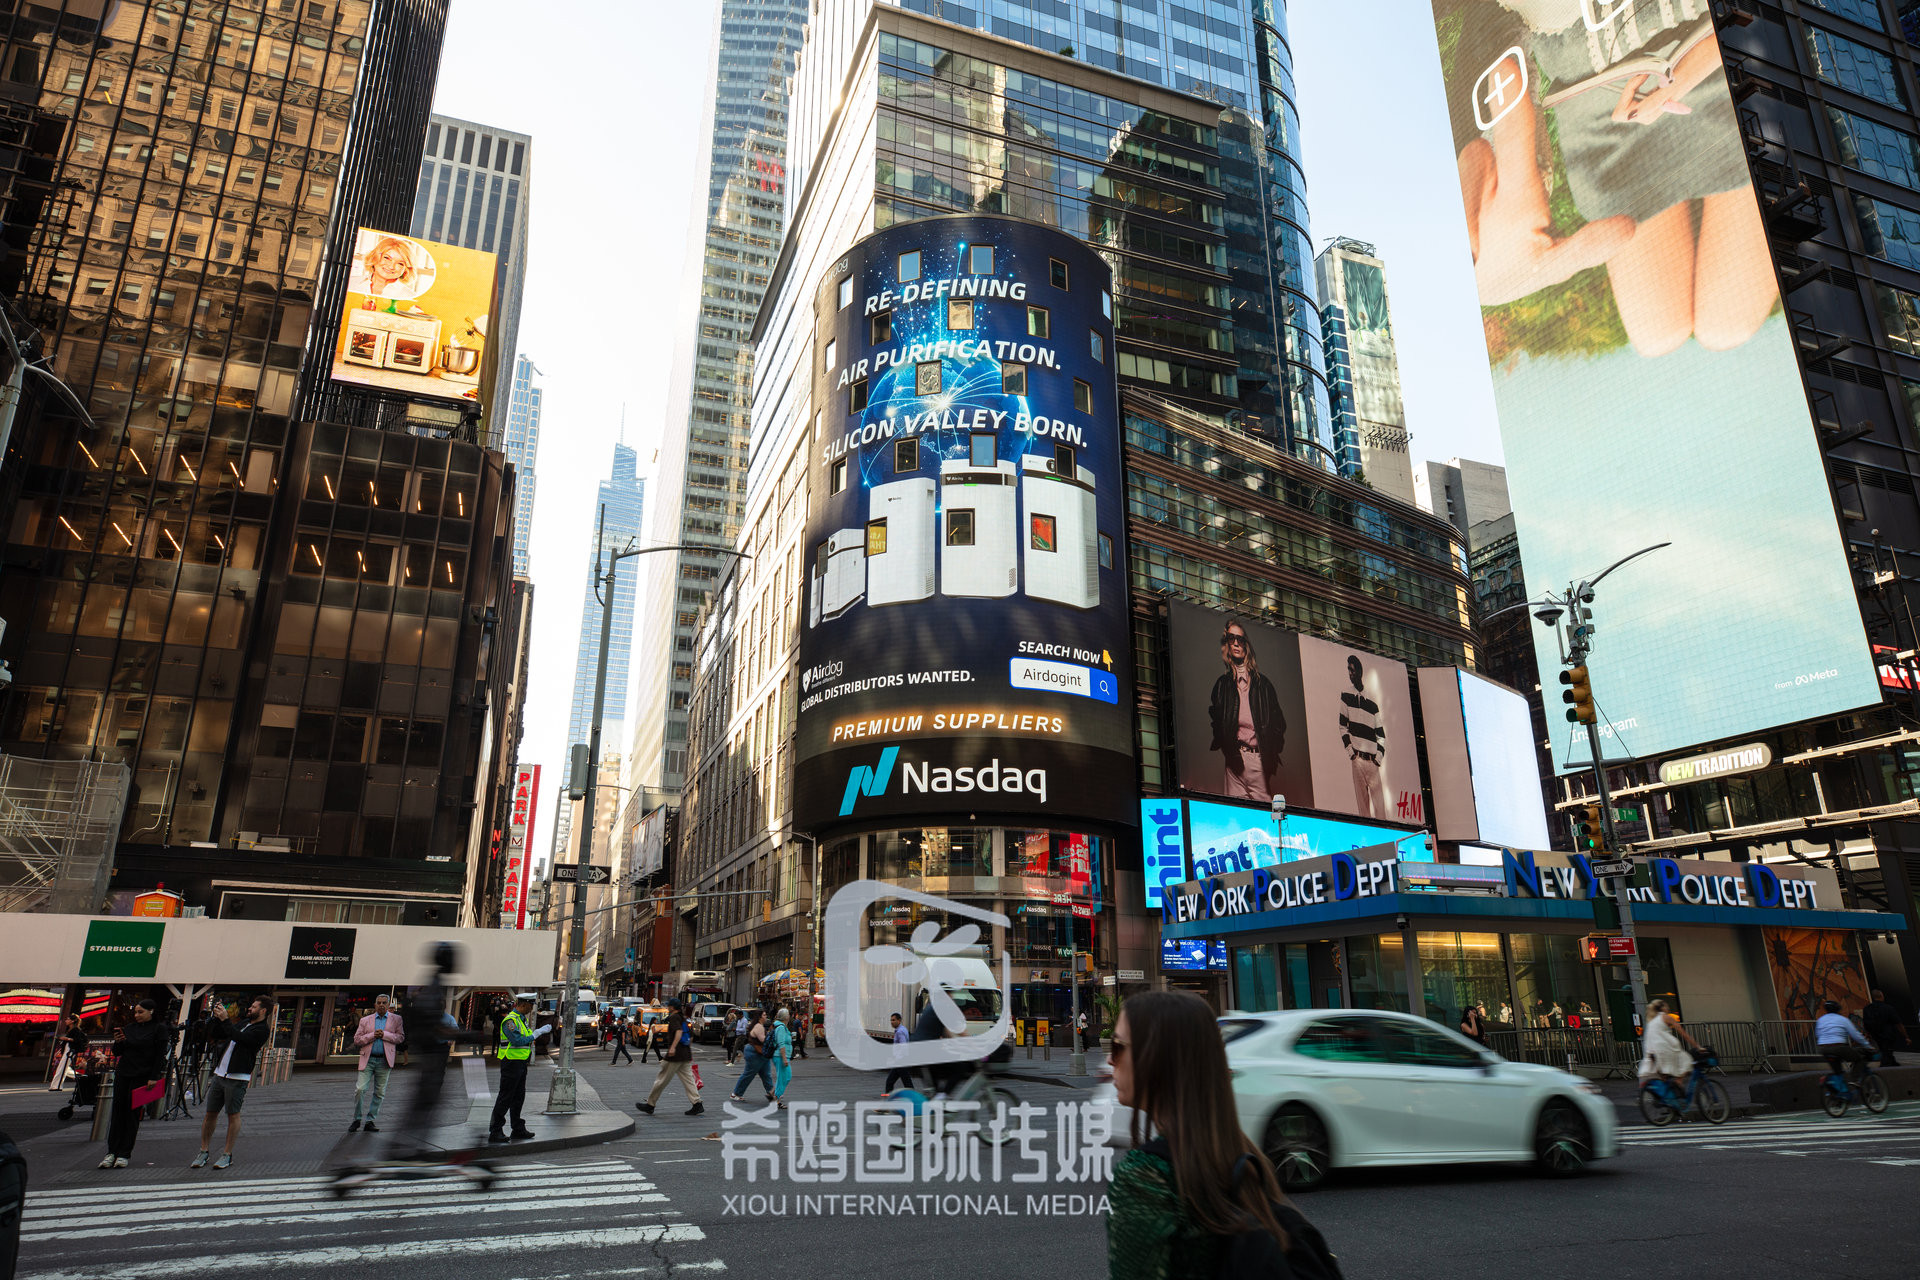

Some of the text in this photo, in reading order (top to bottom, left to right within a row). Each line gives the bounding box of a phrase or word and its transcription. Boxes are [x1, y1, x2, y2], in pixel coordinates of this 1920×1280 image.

[864, 277, 1027, 316] RE-DEFINING
[837, 339, 1061, 391] AIR PURIFICATION.
[822, 408, 1088, 467] SILICON VALLEY BORN.
[812, 660, 843, 683] Airdog
[1018, 640, 1101, 665] SEARCH NOW
[801, 670, 976, 713] GLOBAL DISTRIBUTORS WANTED.
[1023, 667, 1082, 687] Airdogint
[1774, 667, 1838, 690] from Meta
[833, 712, 1063, 742] PREMIUM SUPPLIERS
[513, 772, 531, 825] PARK
[902, 758, 1047, 804] Nasdaq
[1397, 790, 1422, 823] H&M
[1147, 808, 1182, 898] hint
[1192, 841, 1253, 881] hint
[1595, 863, 1629, 874] ONE WAY
[503, 858, 521, 912] PARK
[1162, 884, 1199, 924] NEW
[1199, 877, 1250, 919] YORK
[1253, 868, 1325, 911] POLICE
[1332, 853, 1398, 900] DEPT
[1503, 848, 1575, 898] NEW
[1655, 859, 1749, 906] POLICE
[1750, 864, 1819, 909] DEPT
[892, 905, 911, 913] Nasdaq
[1026, 906, 1047, 914] Nasdaq
[89, 945, 143, 953] STARBUCKS
